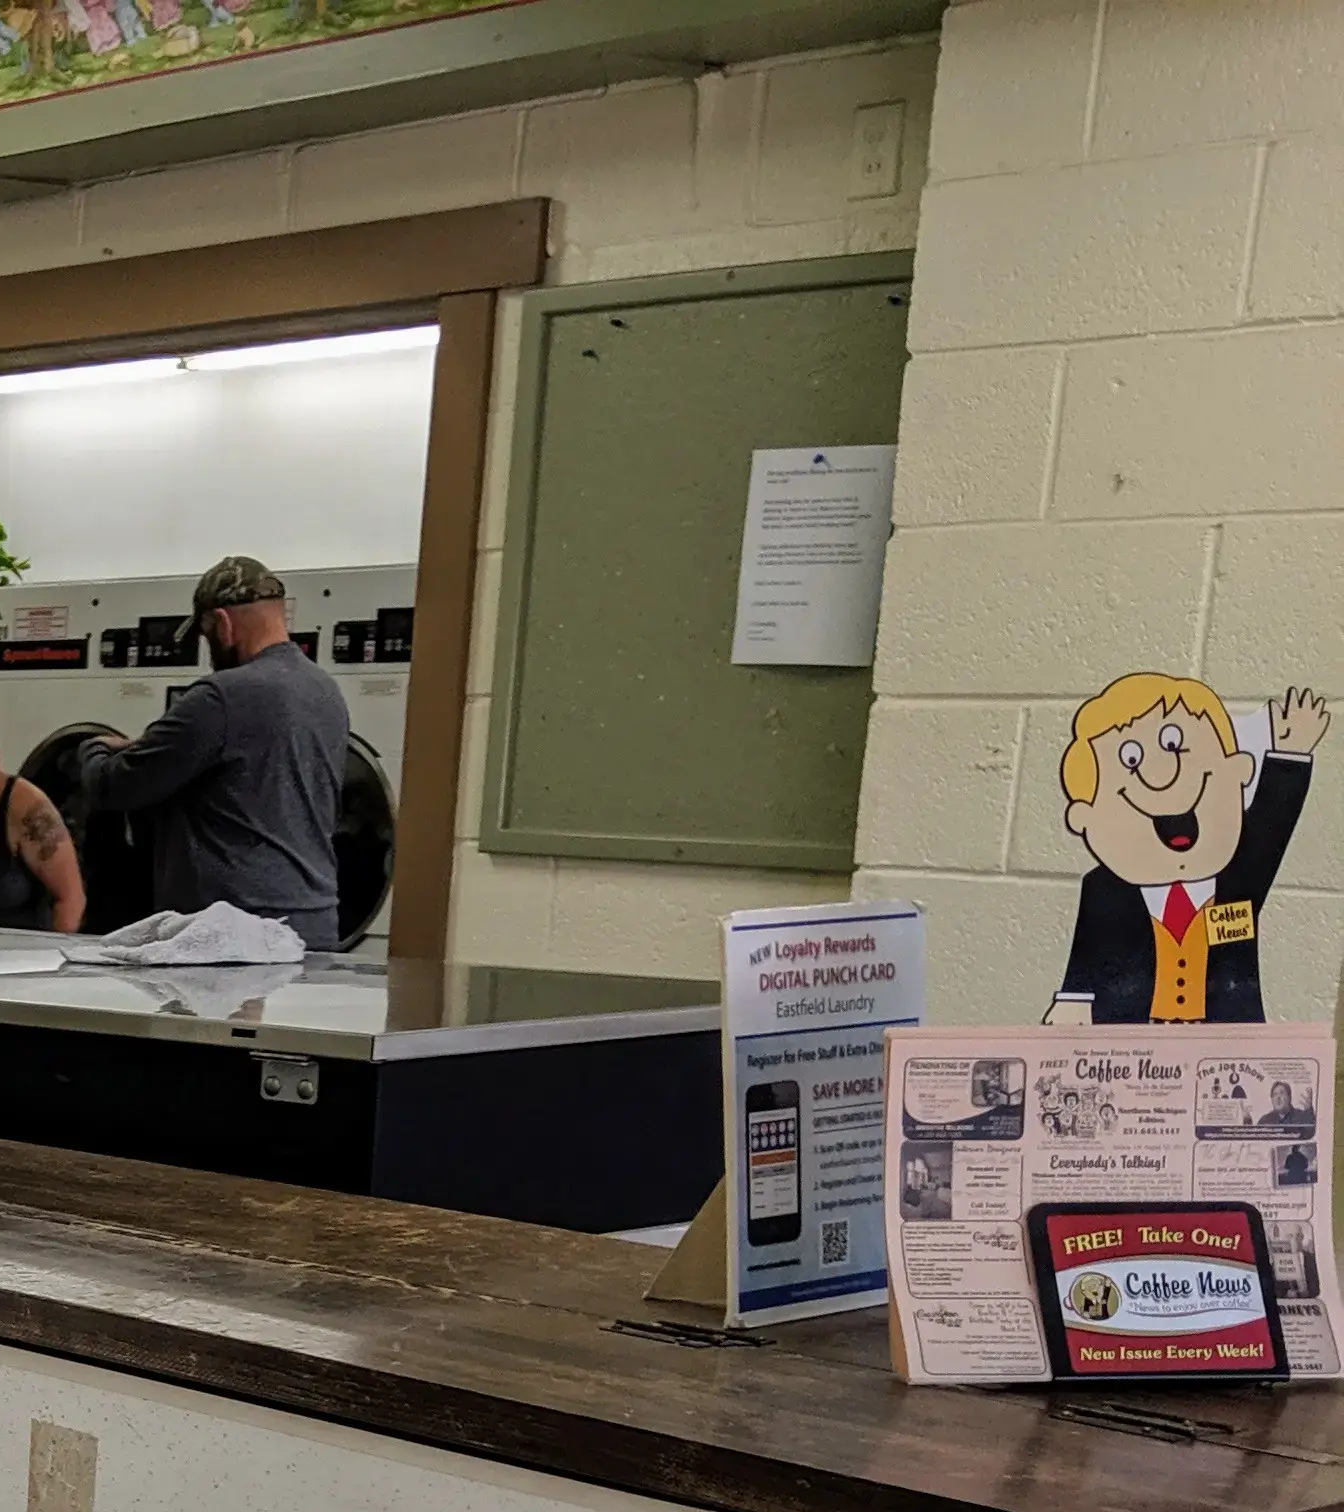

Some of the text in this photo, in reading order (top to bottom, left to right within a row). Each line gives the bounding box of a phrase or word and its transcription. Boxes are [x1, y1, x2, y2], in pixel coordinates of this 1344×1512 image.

[1209, 907, 1249, 926] Coffee
[1216, 924, 1250, 942] News
[750, 934, 876, 966] NEW Loyalty Rewards
[759, 963, 896, 992] DIGITAL PUNCH CARD
[776, 994, 875, 1018] Eastfield Laundry
[747, 1052, 783, 1069] Register
[797, 1049, 816, 1061] Free
[1039, 1059, 1069, 1069] FREE!
[1076, 1058, 1182, 1083] Coffee News
[1197, 1066, 1215, 1080] The
[813, 1078, 875, 1100] SAVE MORE
[1050, 1154, 1166, 1172] Everybody's Talking!
[1064, 1226, 1241, 1255] FREE! Take One!
[1126, 1271, 1252, 1299] Coffee News
[1080, 1343, 1264, 1361] New Issue Every Week!
